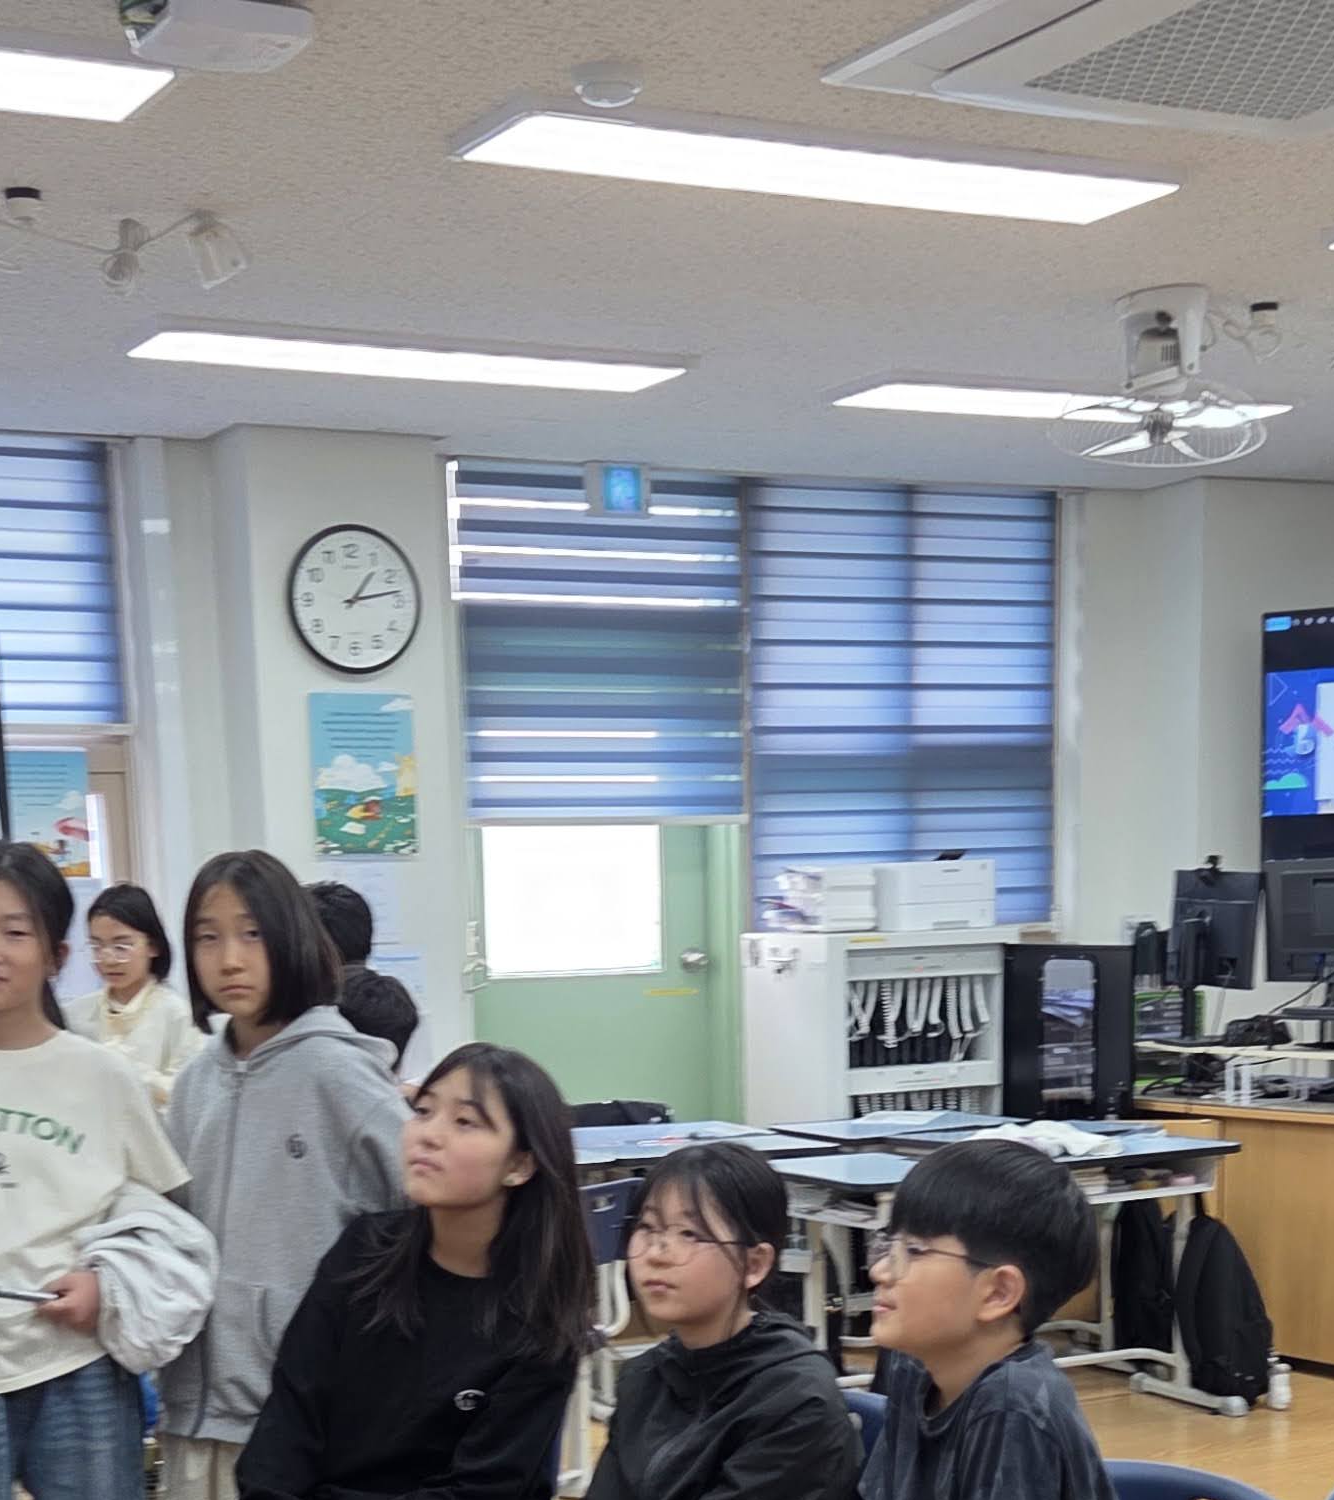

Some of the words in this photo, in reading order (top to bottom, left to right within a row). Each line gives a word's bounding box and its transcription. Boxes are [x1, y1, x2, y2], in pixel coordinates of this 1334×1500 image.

[341, 543, 359, 559] 12
[306, 567, 324, 583] 10
[384, 568, 398, 584] 2
